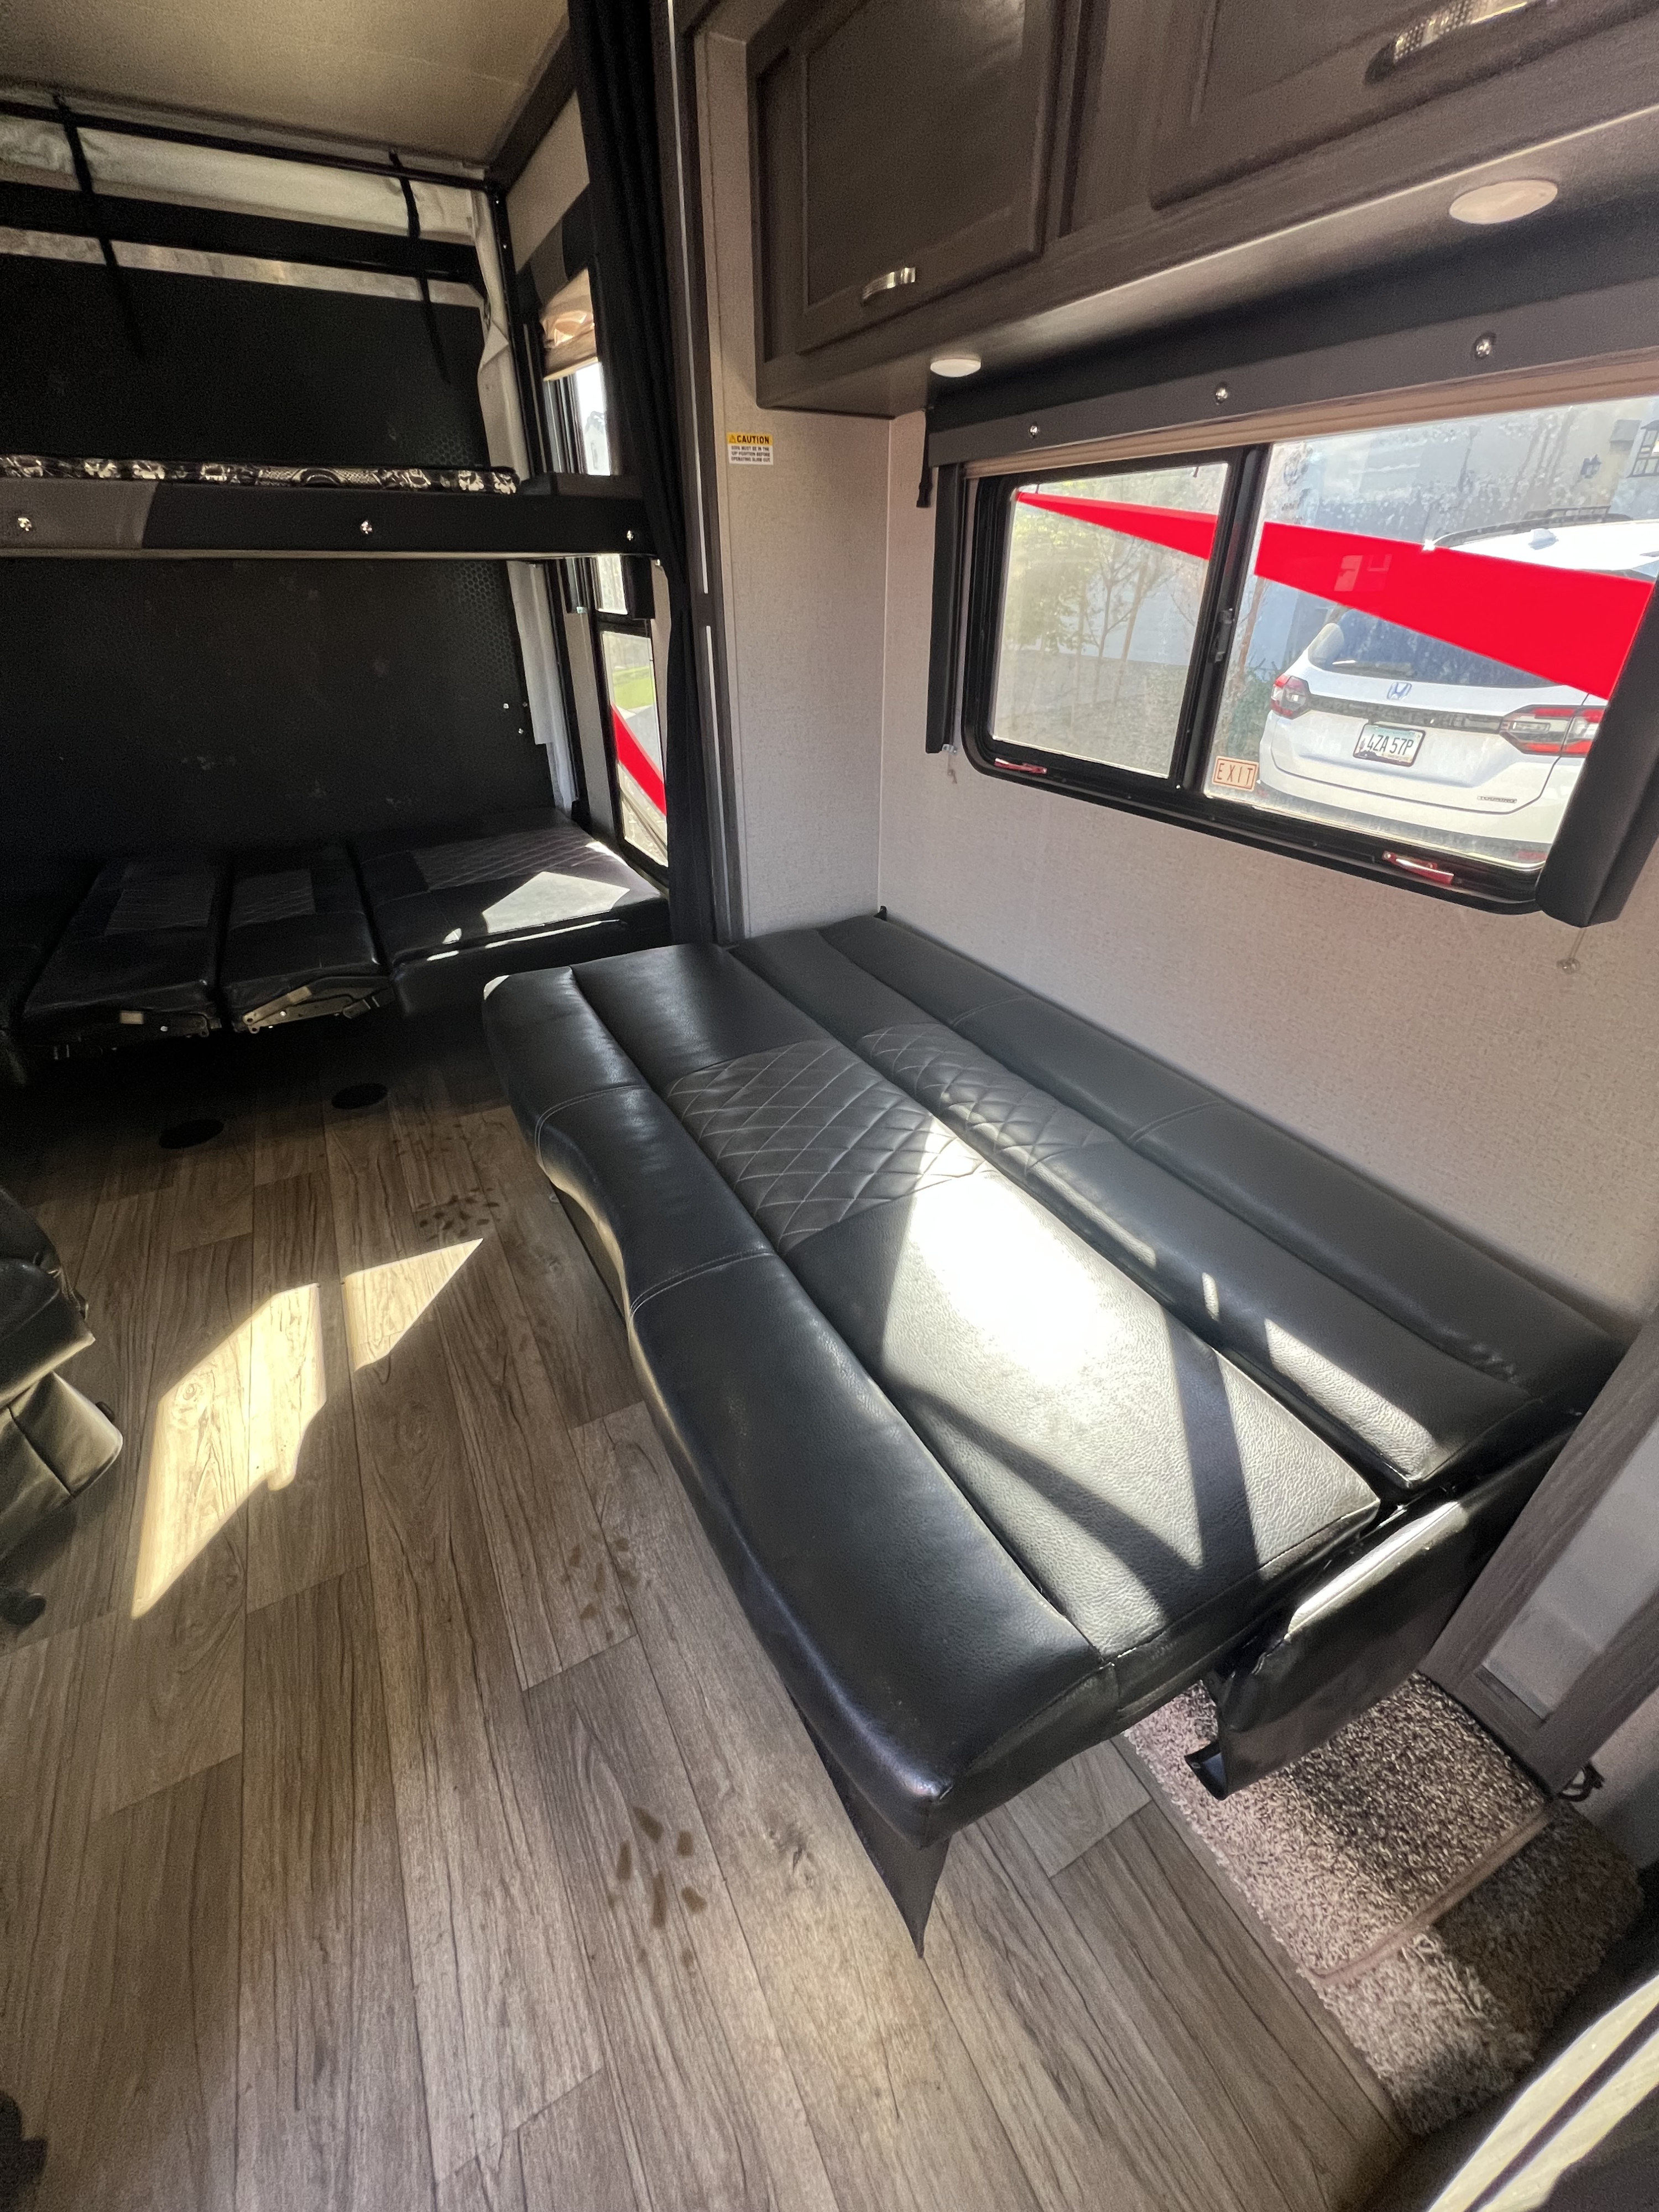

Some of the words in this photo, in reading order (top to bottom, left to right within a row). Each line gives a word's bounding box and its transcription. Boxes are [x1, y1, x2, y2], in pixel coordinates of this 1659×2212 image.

[737, 435, 769, 444] CAUTION
[1367, 734, 1389, 752] 4ZA
[1390, 737, 1414, 755] 57P
[1217, 763, 1253, 785] EXIT
